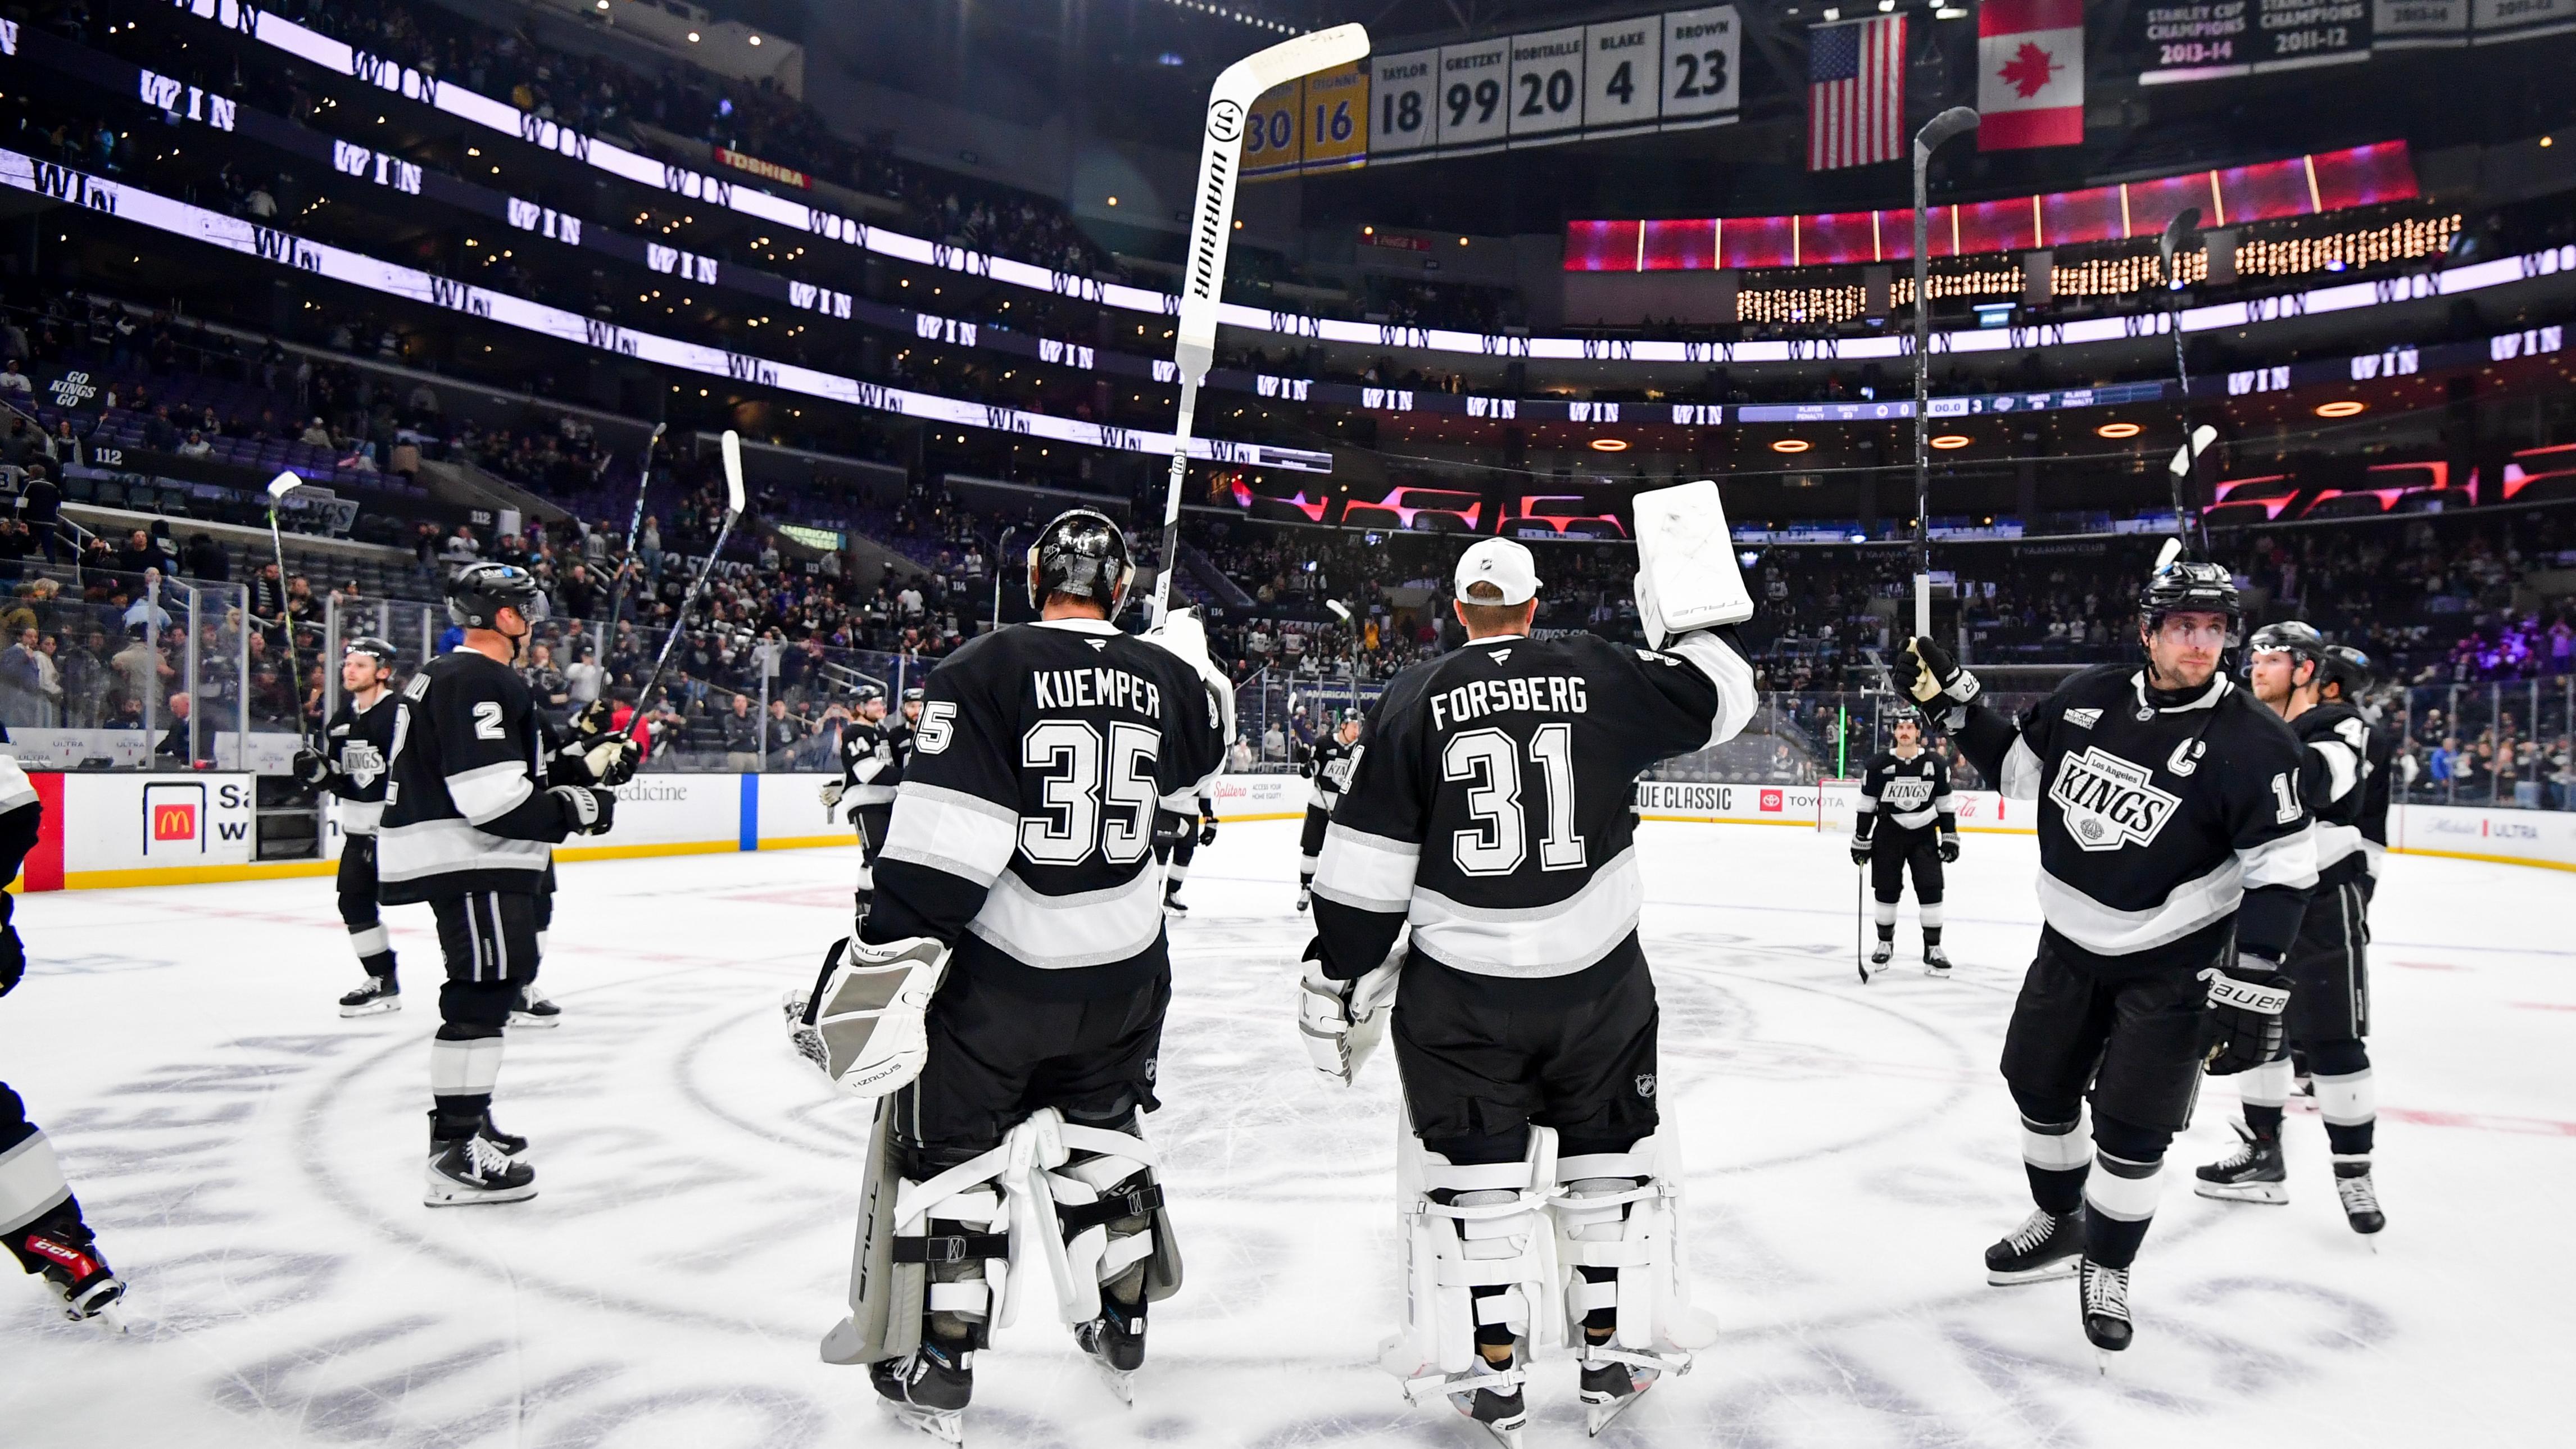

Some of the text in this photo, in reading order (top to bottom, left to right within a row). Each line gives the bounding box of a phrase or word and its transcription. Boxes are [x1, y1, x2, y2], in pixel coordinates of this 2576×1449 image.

[2147, 6, 2210, 24] STANLEY
[2212, 1, 2244, 20] CUP
[2260, 4, 2364, 29] CHAMPIONS
[1600, 31, 1645, 51] BLAKE
[1676, 20, 1729, 40] BROWN
[2147, 17, 2246, 40] CHAMPIONS
[2275, 28, 2348, 54] 2011-12
[1445, 52, 1502, 72] GRETZKY
[2160, 41, 2233, 65] 2013-14
[1382, 62, 1428, 81] TAYLOR
[1606, 60, 1635, 105] 4
[1674, 49, 1727, 99] 23
[139, 69, 236, 131] WIN
[1446, 79, 1500, 126] 99
[1518, 69, 1573, 116] 20
[1316, 100, 1354, 145] 16
[1382, 90, 1423, 135] 18
[1246, 110, 1292, 153] 30
[333, 139, 423, 196] WIN
[724, 148, 805, 187] TOSHIBA
[31, 158, 117, 214] WIN
[507, 196, 582, 246] WIN
[1194, 149, 1228, 300] WARRIOR
[252, 225, 321, 272] WIN
[647, 242, 719, 285] WIN
[430, 275, 492, 317] WIN
[788, 280, 853, 320] WIN
[584, 317, 639, 356] WIN
[916, 312, 978, 347] WIN
[2490, 325, 2563, 361] WIN
[1038, 338, 1095, 370] WIN
[2351, 349, 2419, 380] WIN
[67, 370, 89, 385] GO
[726, 351, 778, 387] WIN
[2228, 366, 2290, 396] WIN
[49, 379, 97, 399] KINGS
[56, 393, 79, 408] GO
[857, 380, 904, 414] WIN
[1257, 374, 1308, 401] WIN
[1362, 388, 1413, 414] WIN
[986, 406, 1031, 435] WIN
[1466, 396, 1516, 419] WIN
[1569, 402, 1620, 423] WIN
[1672, 405, 1723, 425] WIN
[1934, 403, 1961, 412] 00.0
[1099, 425, 1141, 451] WIN
[1209, 439, 1251, 463] WIN
[96, 447, 123, 465] 112
[470, 510, 492, 525] 112
[1670, 599, 1746, 618] TRUE
[1033, 667, 1160, 720] KUEMPER
[1306, 689, 1352, 699] AMERICAN
[1429, 675, 1588, 732] FORSBERG
[472, 701, 505, 740] 2
[914, 701, 957, 754] 5
[2063, 715, 2094, 730] INSURANCE
[2065, 708, 2097, 725] MERCURY
[846, 736, 869, 756] 14
[2166, 737, 2206, 778] C
[1922, 760, 1935, 776] A
[2091, 758, 2138, 784] Los Angeles
[614, 779, 687, 802] edicine
[1017, 719, 1163, 866] 35
[1214, 782, 1247, 806] Splitero
[1442, 723, 1588, 877] 31
[1640, 785, 1732, 810] UE CLASSIC
[1789, 796, 1845, 809] TOYOTA
[1886, 785, 1930, 798] KINGS
[2058, 762, 2165, 832] KINGS
[2495, 823, 2538, 838] ULTRA
[35, 1238, 79, 1260] CCM
[859, 1181, 879, 1303] TRUE
